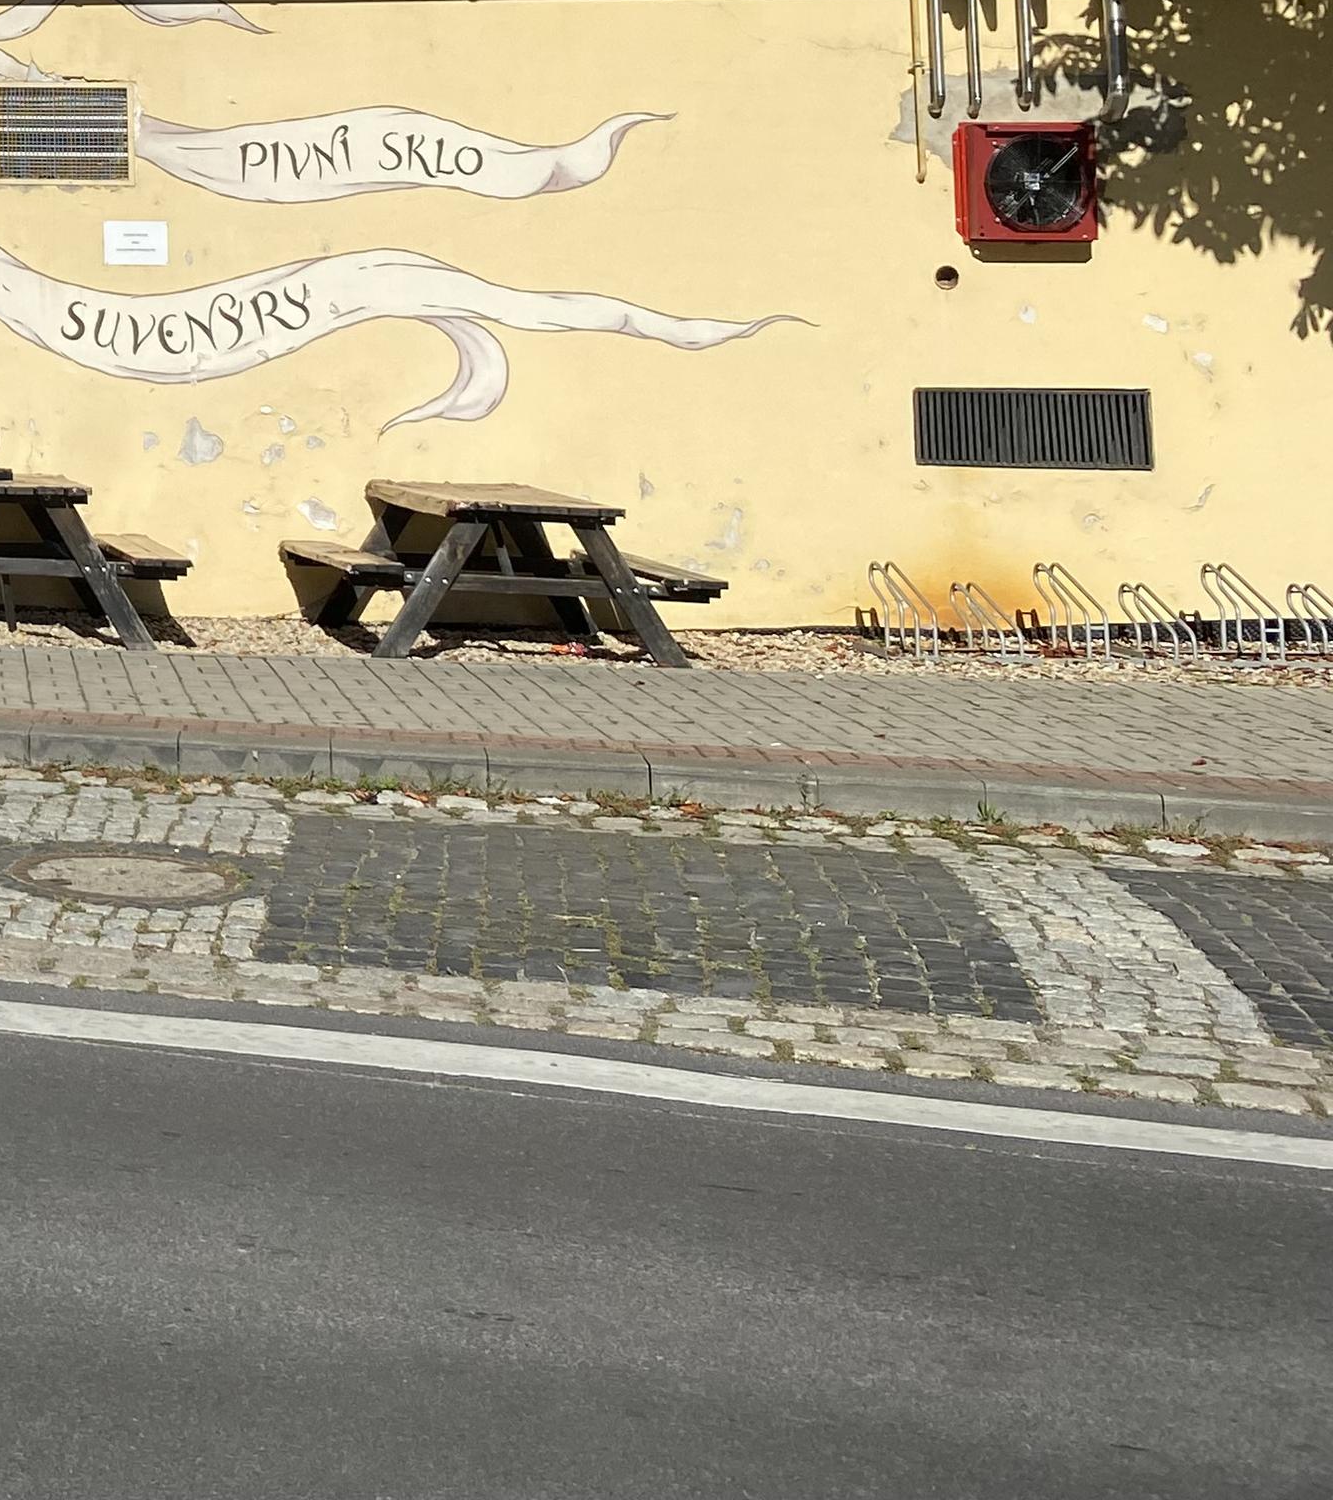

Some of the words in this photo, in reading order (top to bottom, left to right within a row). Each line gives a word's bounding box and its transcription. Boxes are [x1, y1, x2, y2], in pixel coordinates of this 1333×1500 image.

[238, 124, 352, 183] PIVNÍ
[378, 131, 484, 178] SKLO
[60, 282, 311, 357] SUVENÝRY
